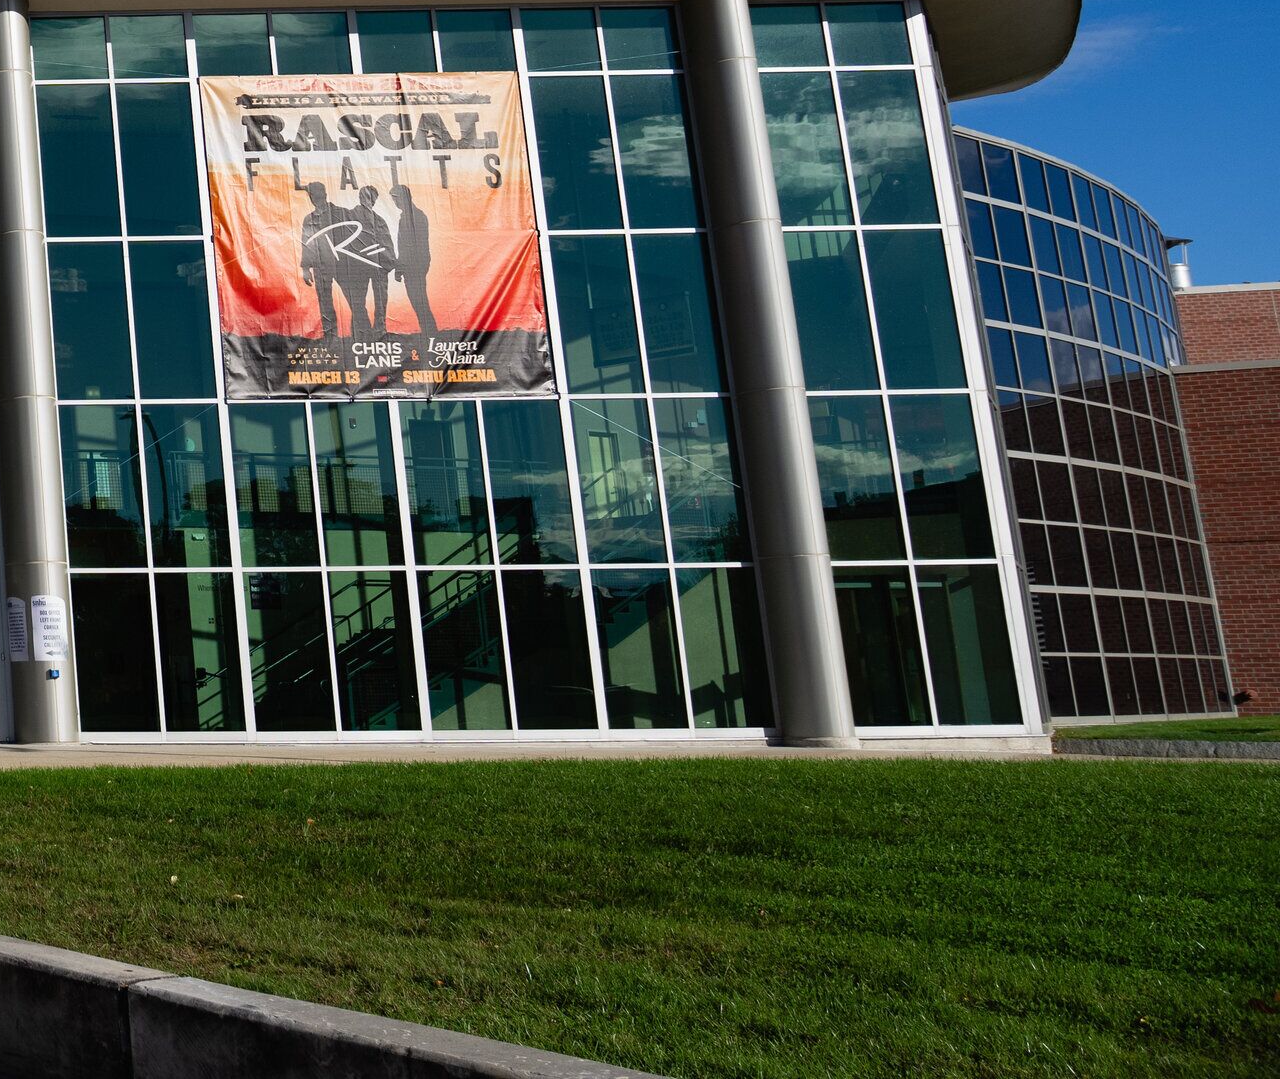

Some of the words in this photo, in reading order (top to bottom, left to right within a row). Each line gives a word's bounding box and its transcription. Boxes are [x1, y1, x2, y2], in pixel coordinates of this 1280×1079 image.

[252, 96, 290, 105] LIFE
[294, 96, 310, 104] IS
[314, 96, 324, 104] A
[329, 94, 402, 104] HIGHWAY
[408, 93, 451, 103] TOUR
[242, 112, 499, 152] RASCAL
[245, 153, 502, 192] FLATTS
[352, 342, 403, 355] CHRIS
[427, 338, 478, 353] Lauren
[355, 356, 402, 368] LANE
[411, 349, 420, 361] &
[428, 353, 486, 368] Alaina
[288, 371, 342, 384] MARCH
[345, 371, 360, 384] 13
[403, 370, 446, 384] SNHU
[448, 369, 497, 383] ARENA
